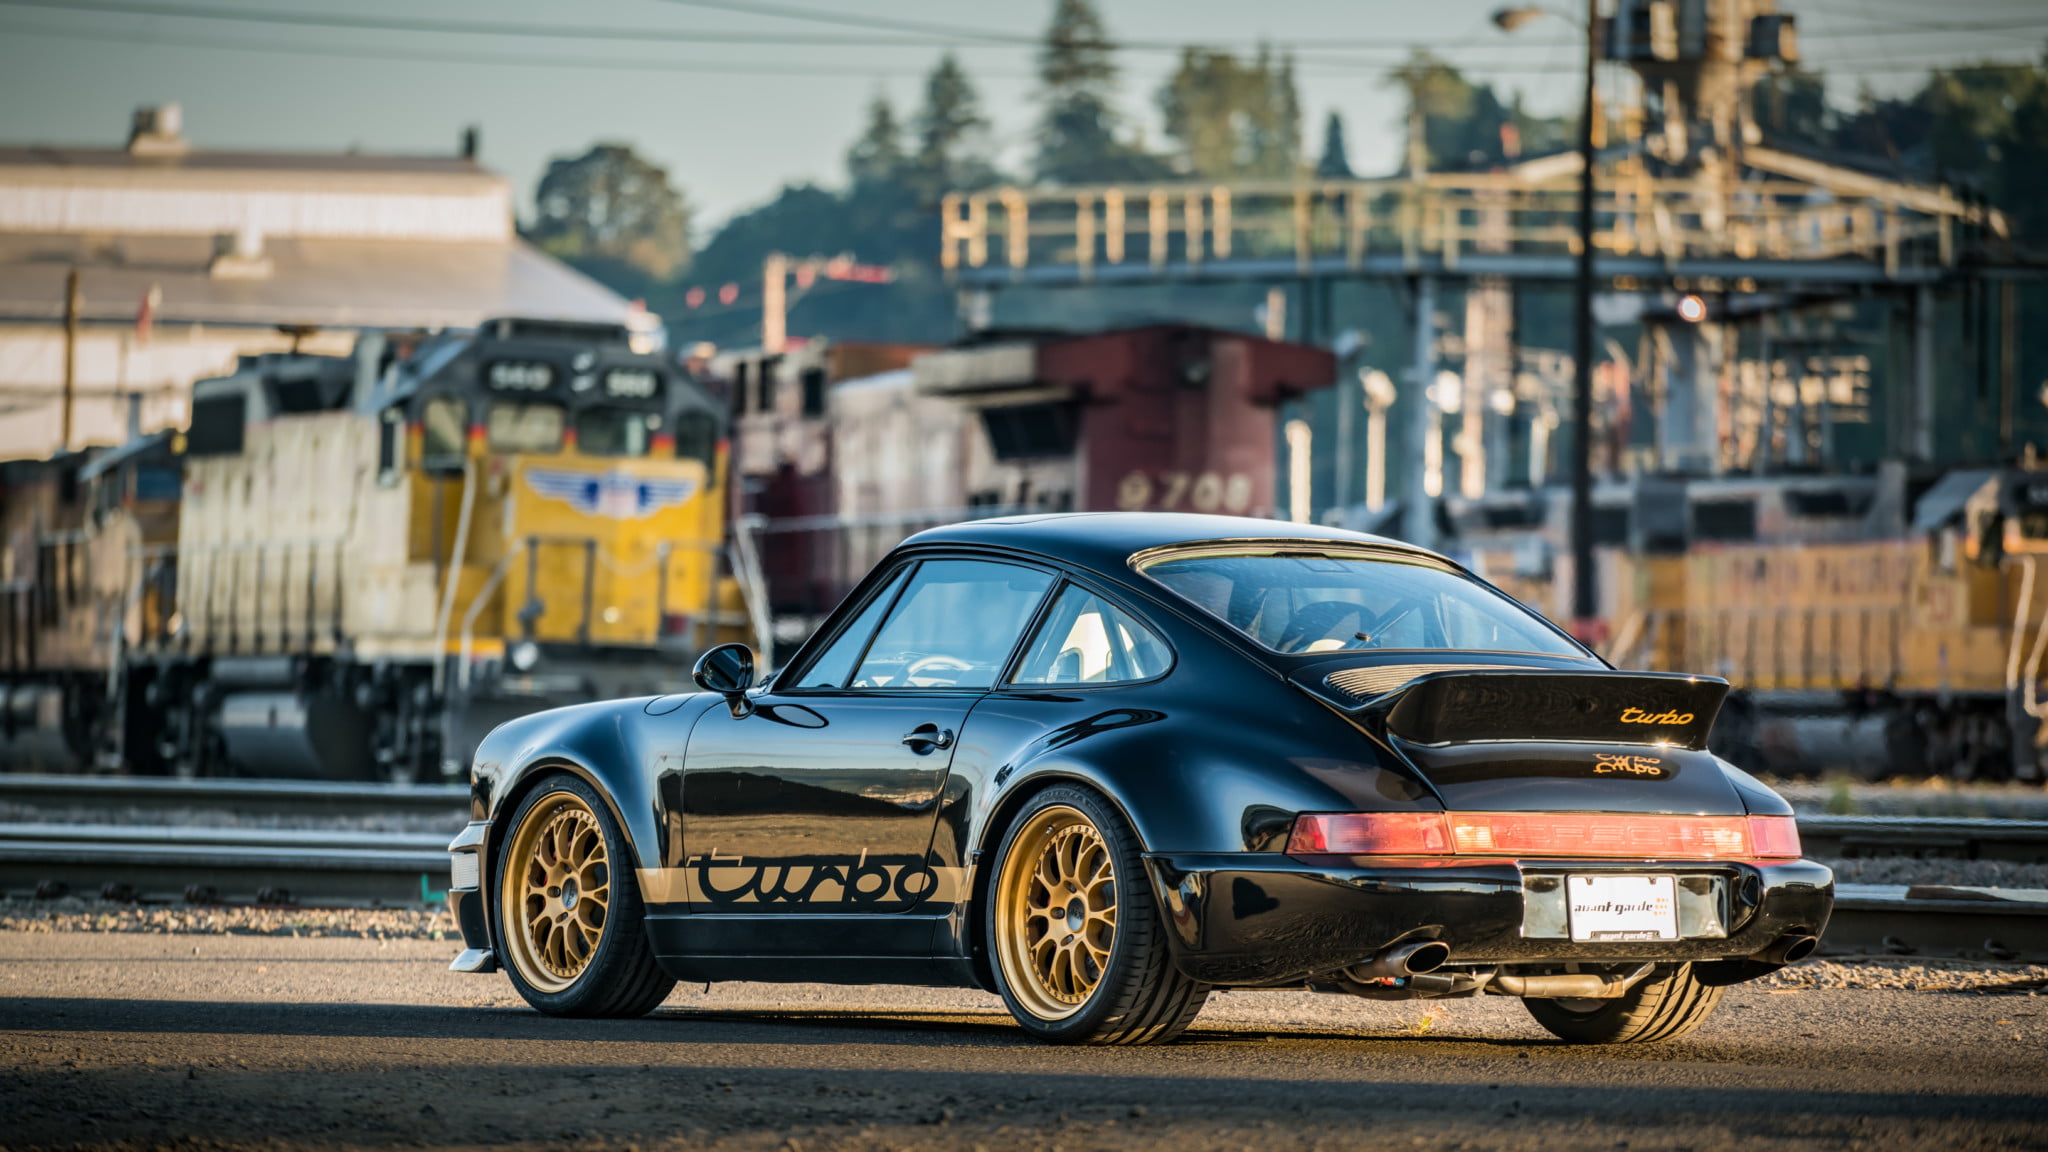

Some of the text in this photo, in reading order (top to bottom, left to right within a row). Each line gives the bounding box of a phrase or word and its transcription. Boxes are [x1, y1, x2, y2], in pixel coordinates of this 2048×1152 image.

[1620, 707, 1694, 725] turbo
[686, 848, 939, 903] turbo
[1574, 901, 1653, 915] avant garde
